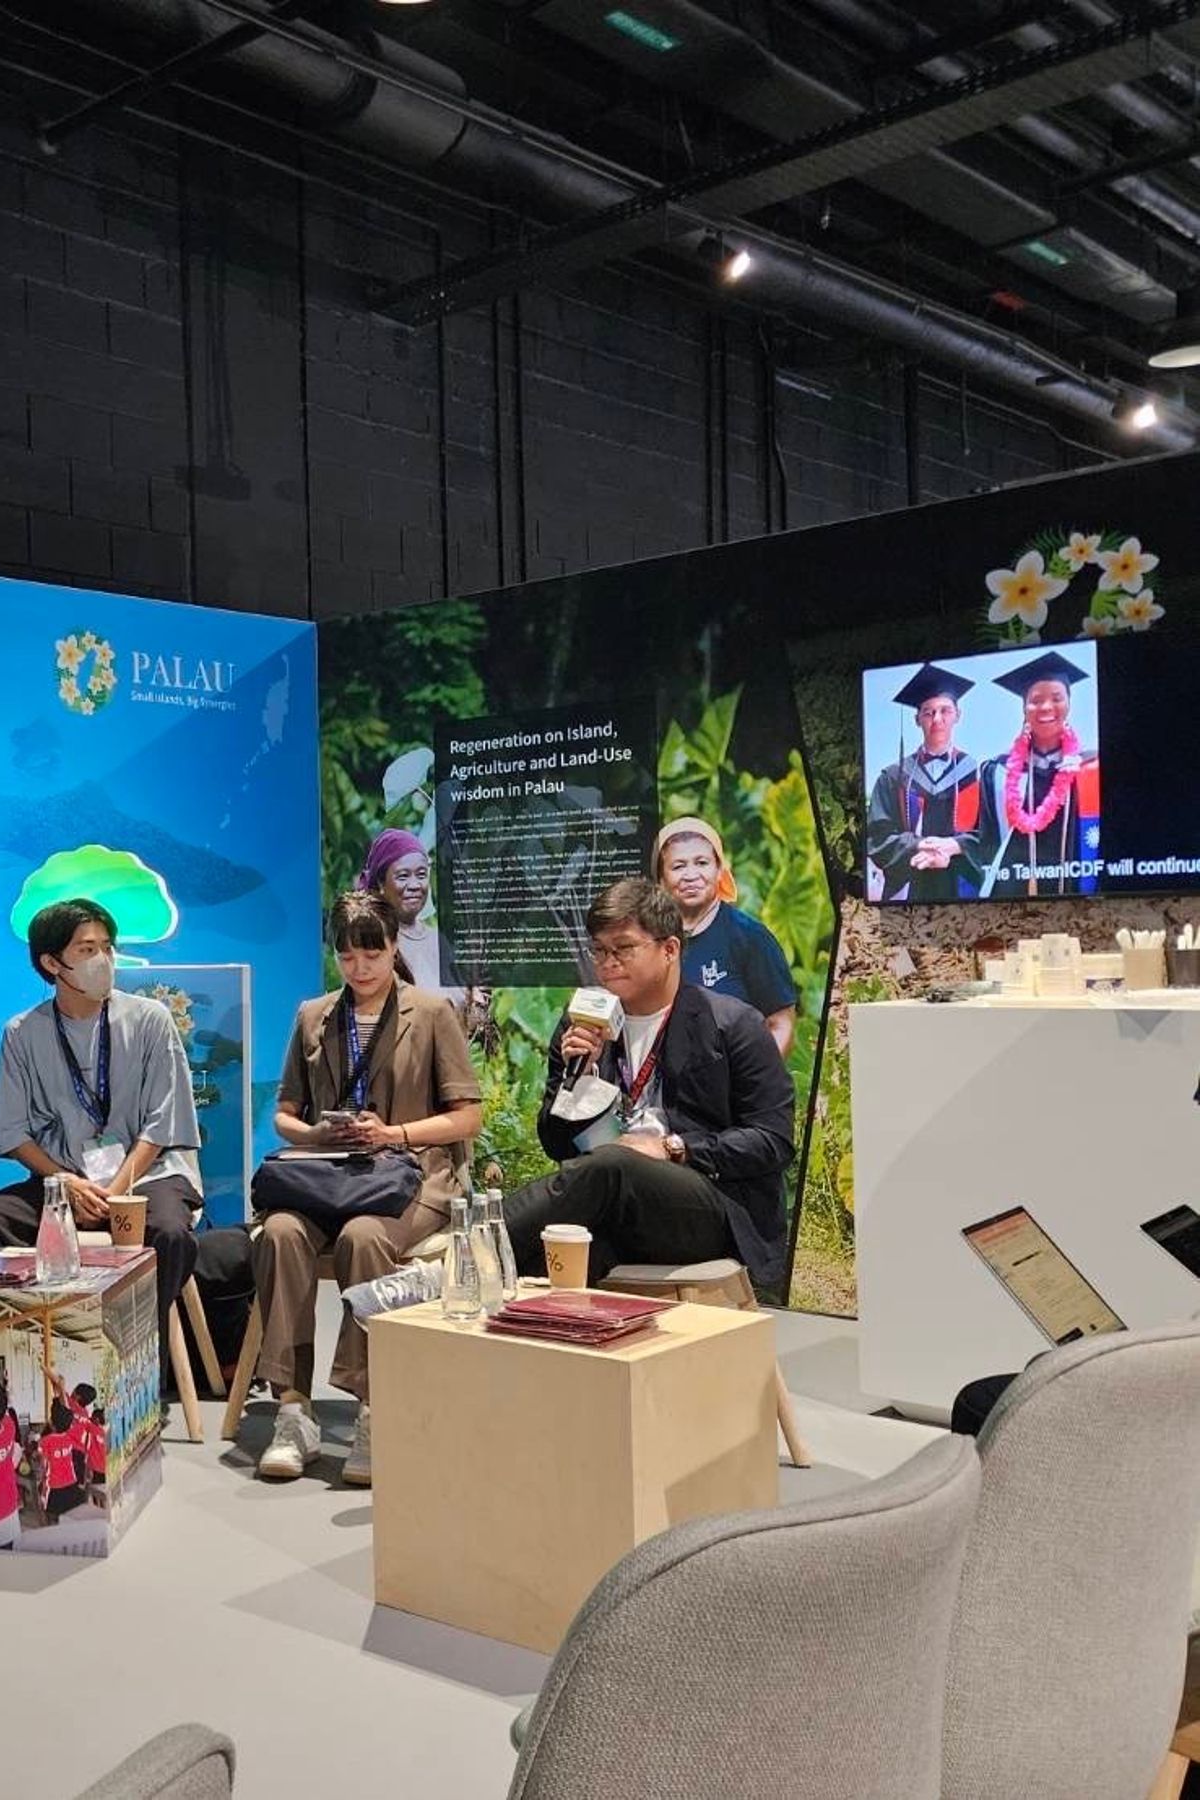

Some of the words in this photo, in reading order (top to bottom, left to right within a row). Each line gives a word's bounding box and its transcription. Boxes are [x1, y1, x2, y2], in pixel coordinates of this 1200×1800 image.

[131, 651, 236, 692] PALAU
[450, 731, 541, 756] Regeneration
[545, 728, 564, 743] on
[567, 721, 618, 741] Island,
[450, 758, 526, 781] Agriculture
[529, 753, 557, 770] and
[560, 746, 632, 768] Land-Use
[450, 785, 504, 802] wisdom
[508, 781, 522, 797] in
[525, 779, 565, 795] Palau
[1107, 858, 1134, 876] will
